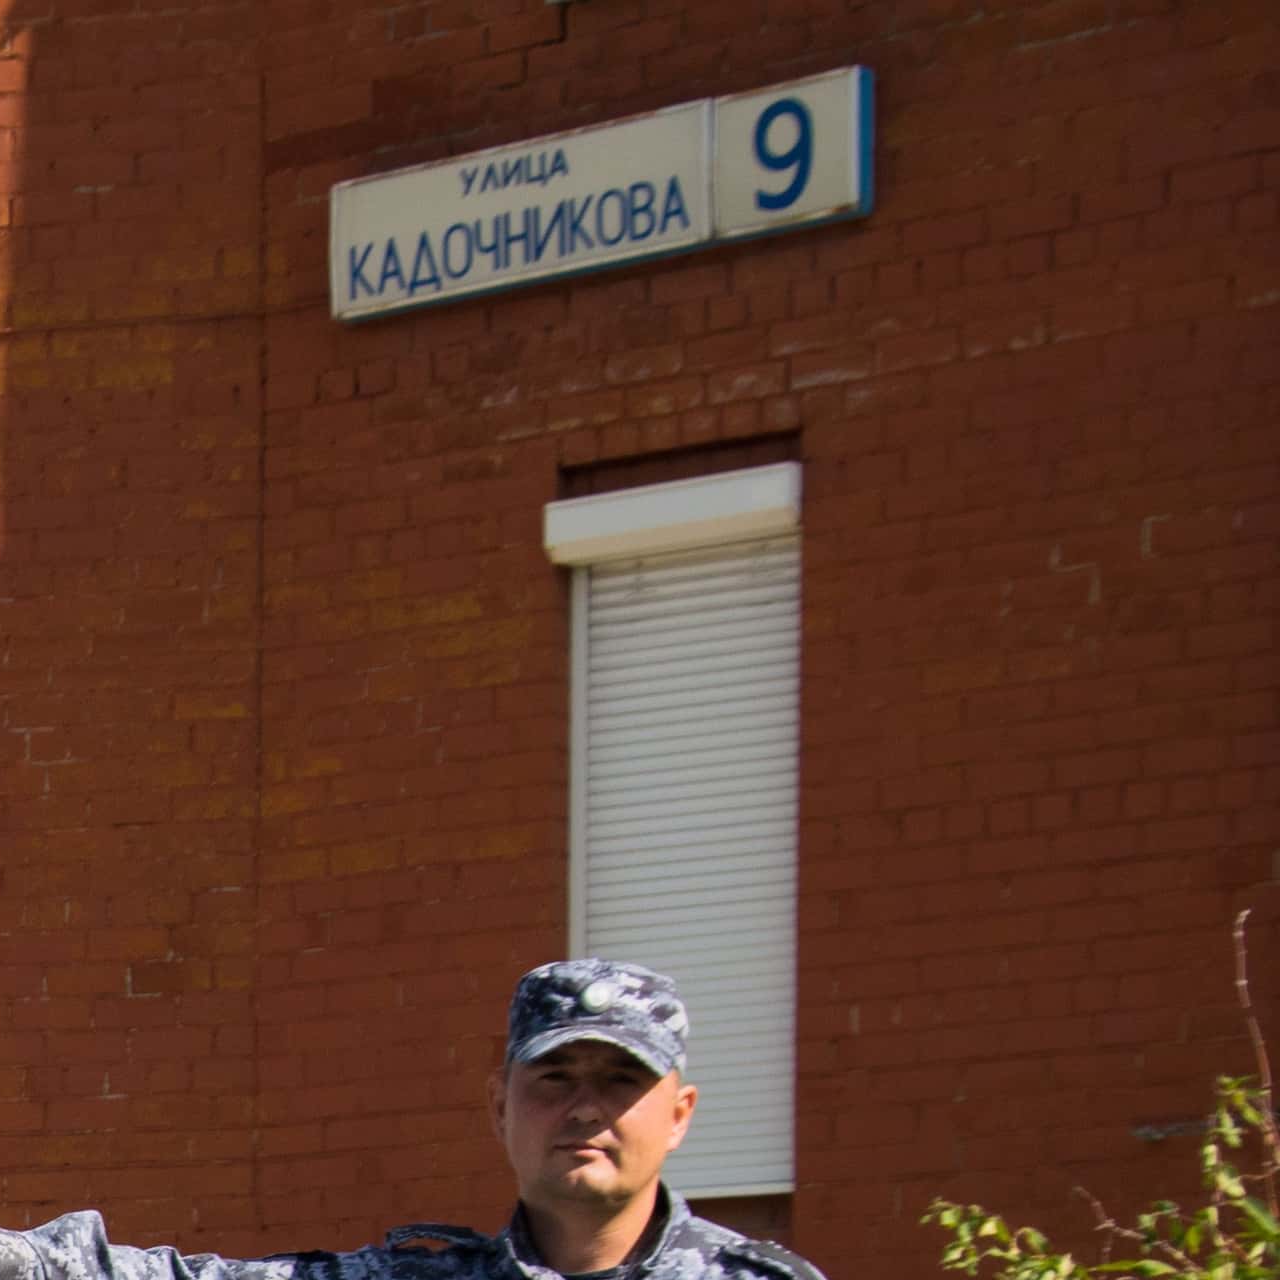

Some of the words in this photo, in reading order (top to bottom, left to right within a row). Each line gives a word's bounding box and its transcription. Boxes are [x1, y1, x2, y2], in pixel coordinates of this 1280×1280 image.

[460, 148, 569, 197] УЛИЦА
[753, 97, 815, 211] 9
[348, 175, 690, 299] КАДОЧНИКОВА
